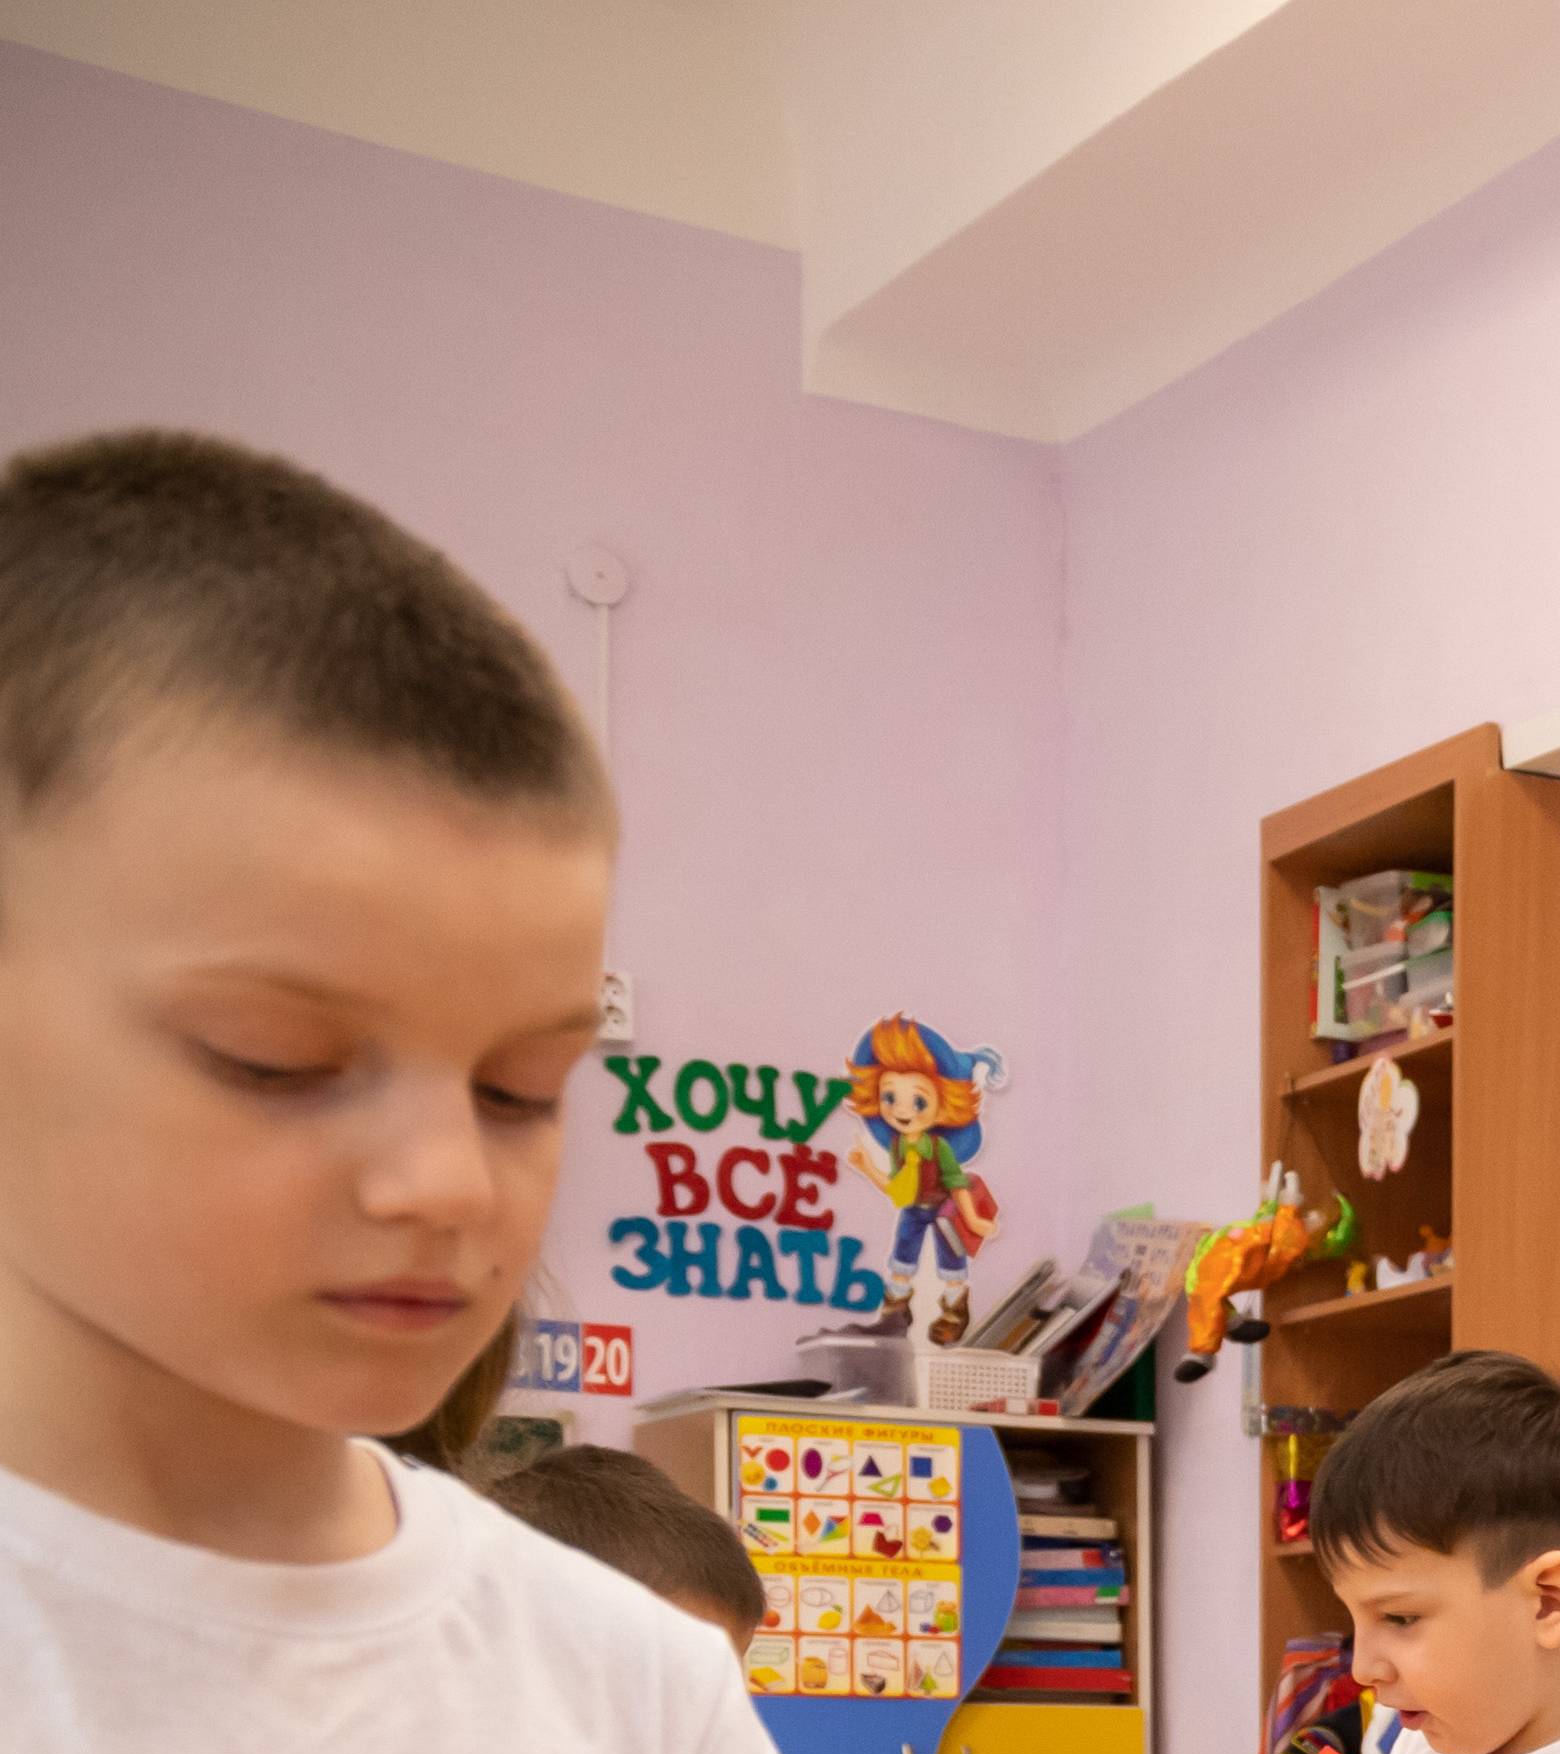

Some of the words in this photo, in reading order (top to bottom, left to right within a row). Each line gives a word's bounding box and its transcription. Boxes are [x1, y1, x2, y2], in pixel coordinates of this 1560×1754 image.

[604, 1055, 854, 1143] ХОЧУ
[609, 1216, 885, 1313] ЗНАТЬ
[536, 1333, 578, 1382] 19
[583, 1335, 630, 1387] 20
[765, 1421, 854, 1438] ПЛОСКИЕ
[863, 1428, 934, 1442] ФИГУРЫ
[882, 1564, 922, 1577] ТЕЛА
